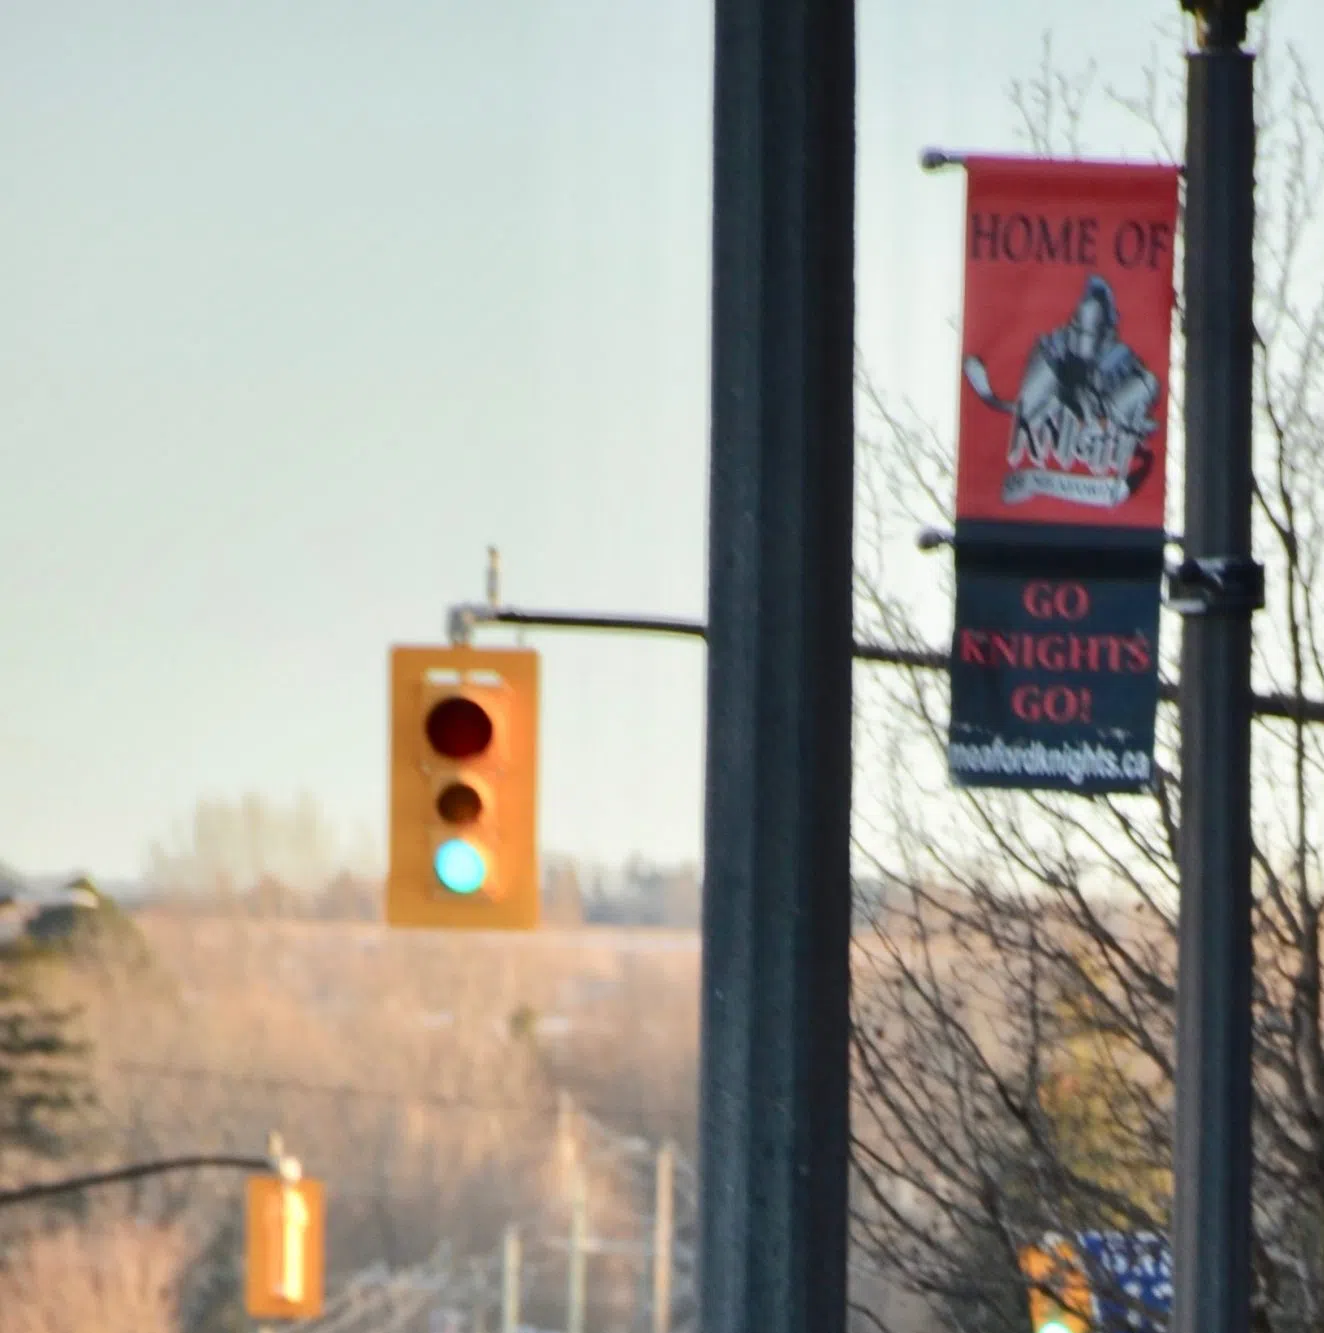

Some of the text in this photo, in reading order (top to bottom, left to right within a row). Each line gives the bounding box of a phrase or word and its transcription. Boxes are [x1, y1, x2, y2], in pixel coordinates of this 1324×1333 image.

[970, 211, 1169, 270] HOME OF
[1022, 578, 1091, 621] GO
[959, 627, 1150, 673] KNIGHTS
[1011, 683, 1092, 724] GO!
